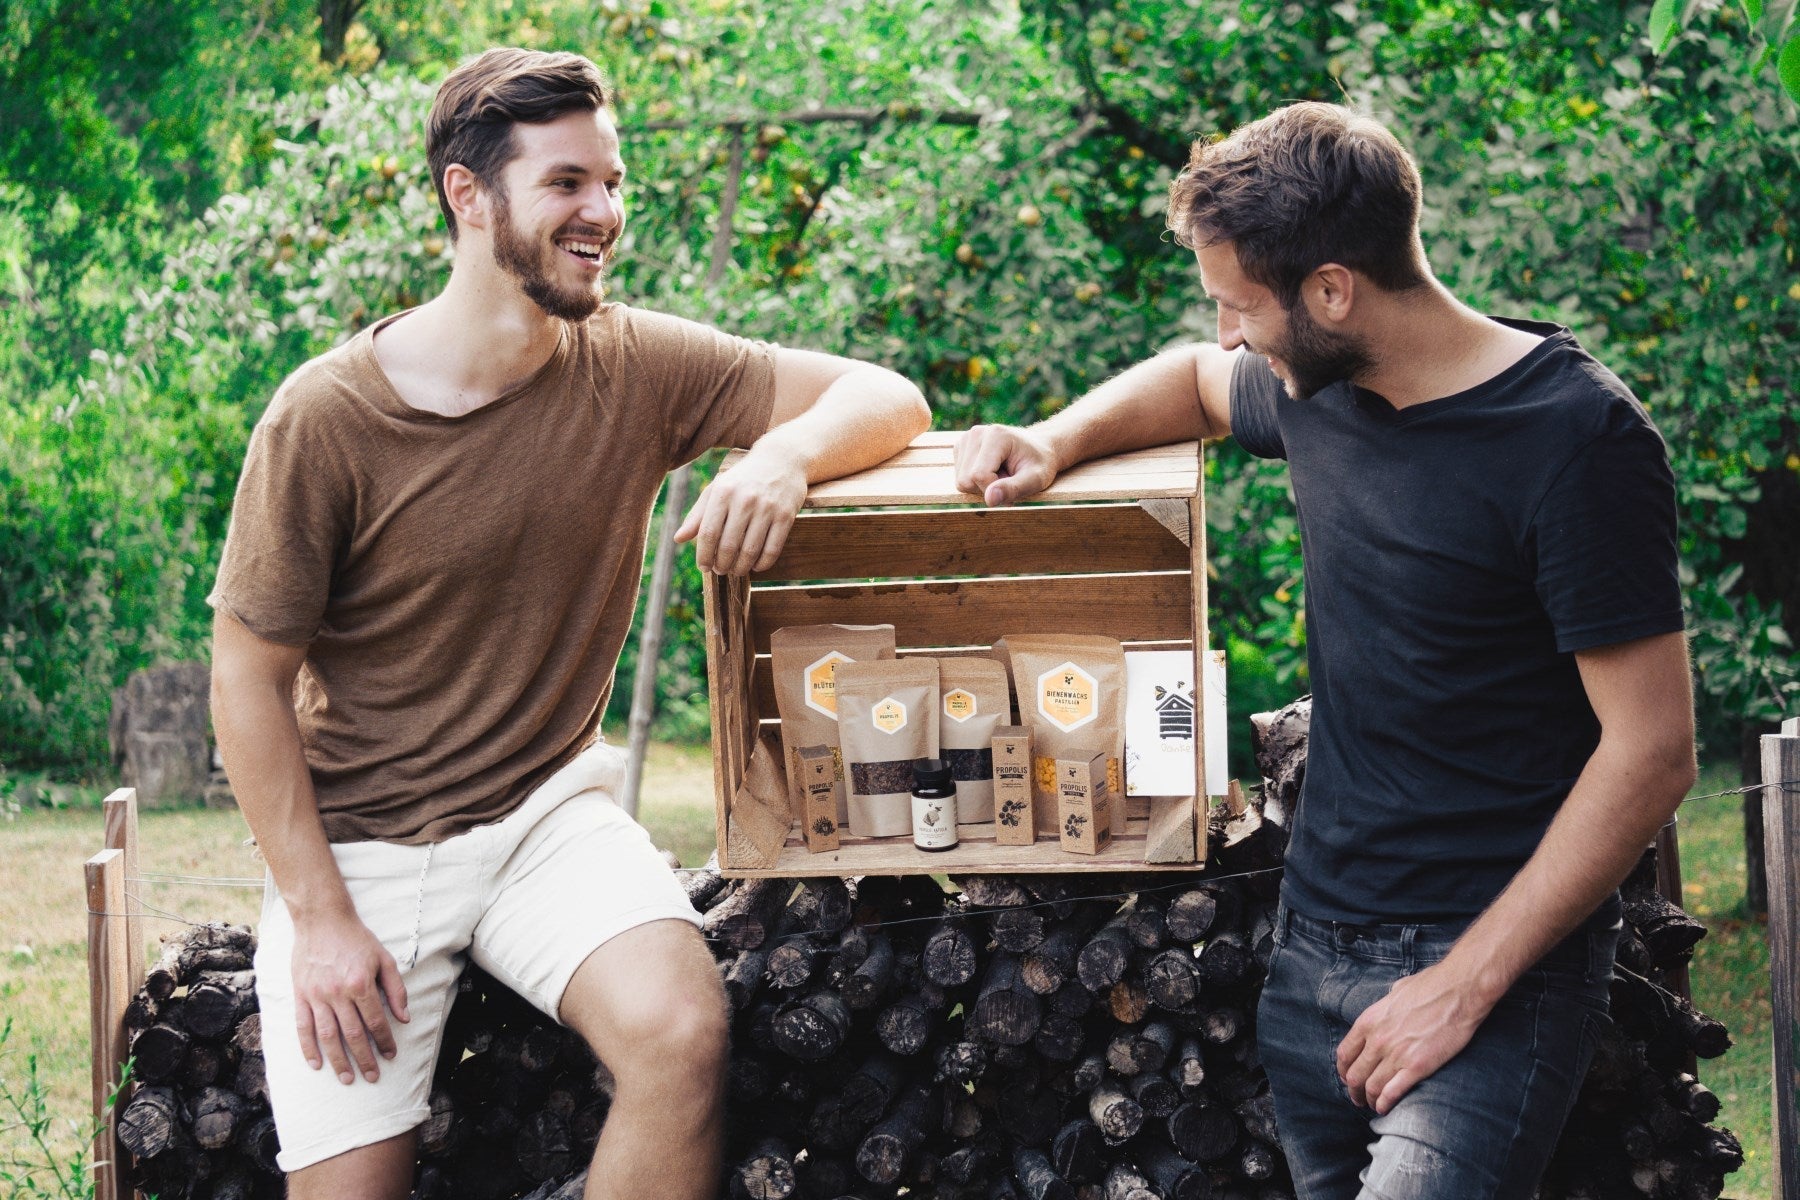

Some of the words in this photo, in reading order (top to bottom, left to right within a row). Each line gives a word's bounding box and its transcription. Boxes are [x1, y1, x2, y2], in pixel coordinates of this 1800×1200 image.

[1046, 690, 1088, 700] BIENENWACHS
[996, 766, 1028, 775] PROPOLIS
[808, 781, 834, 791] PROPOLIS
[1060, 783, 1088, 793] PROPOLIS
